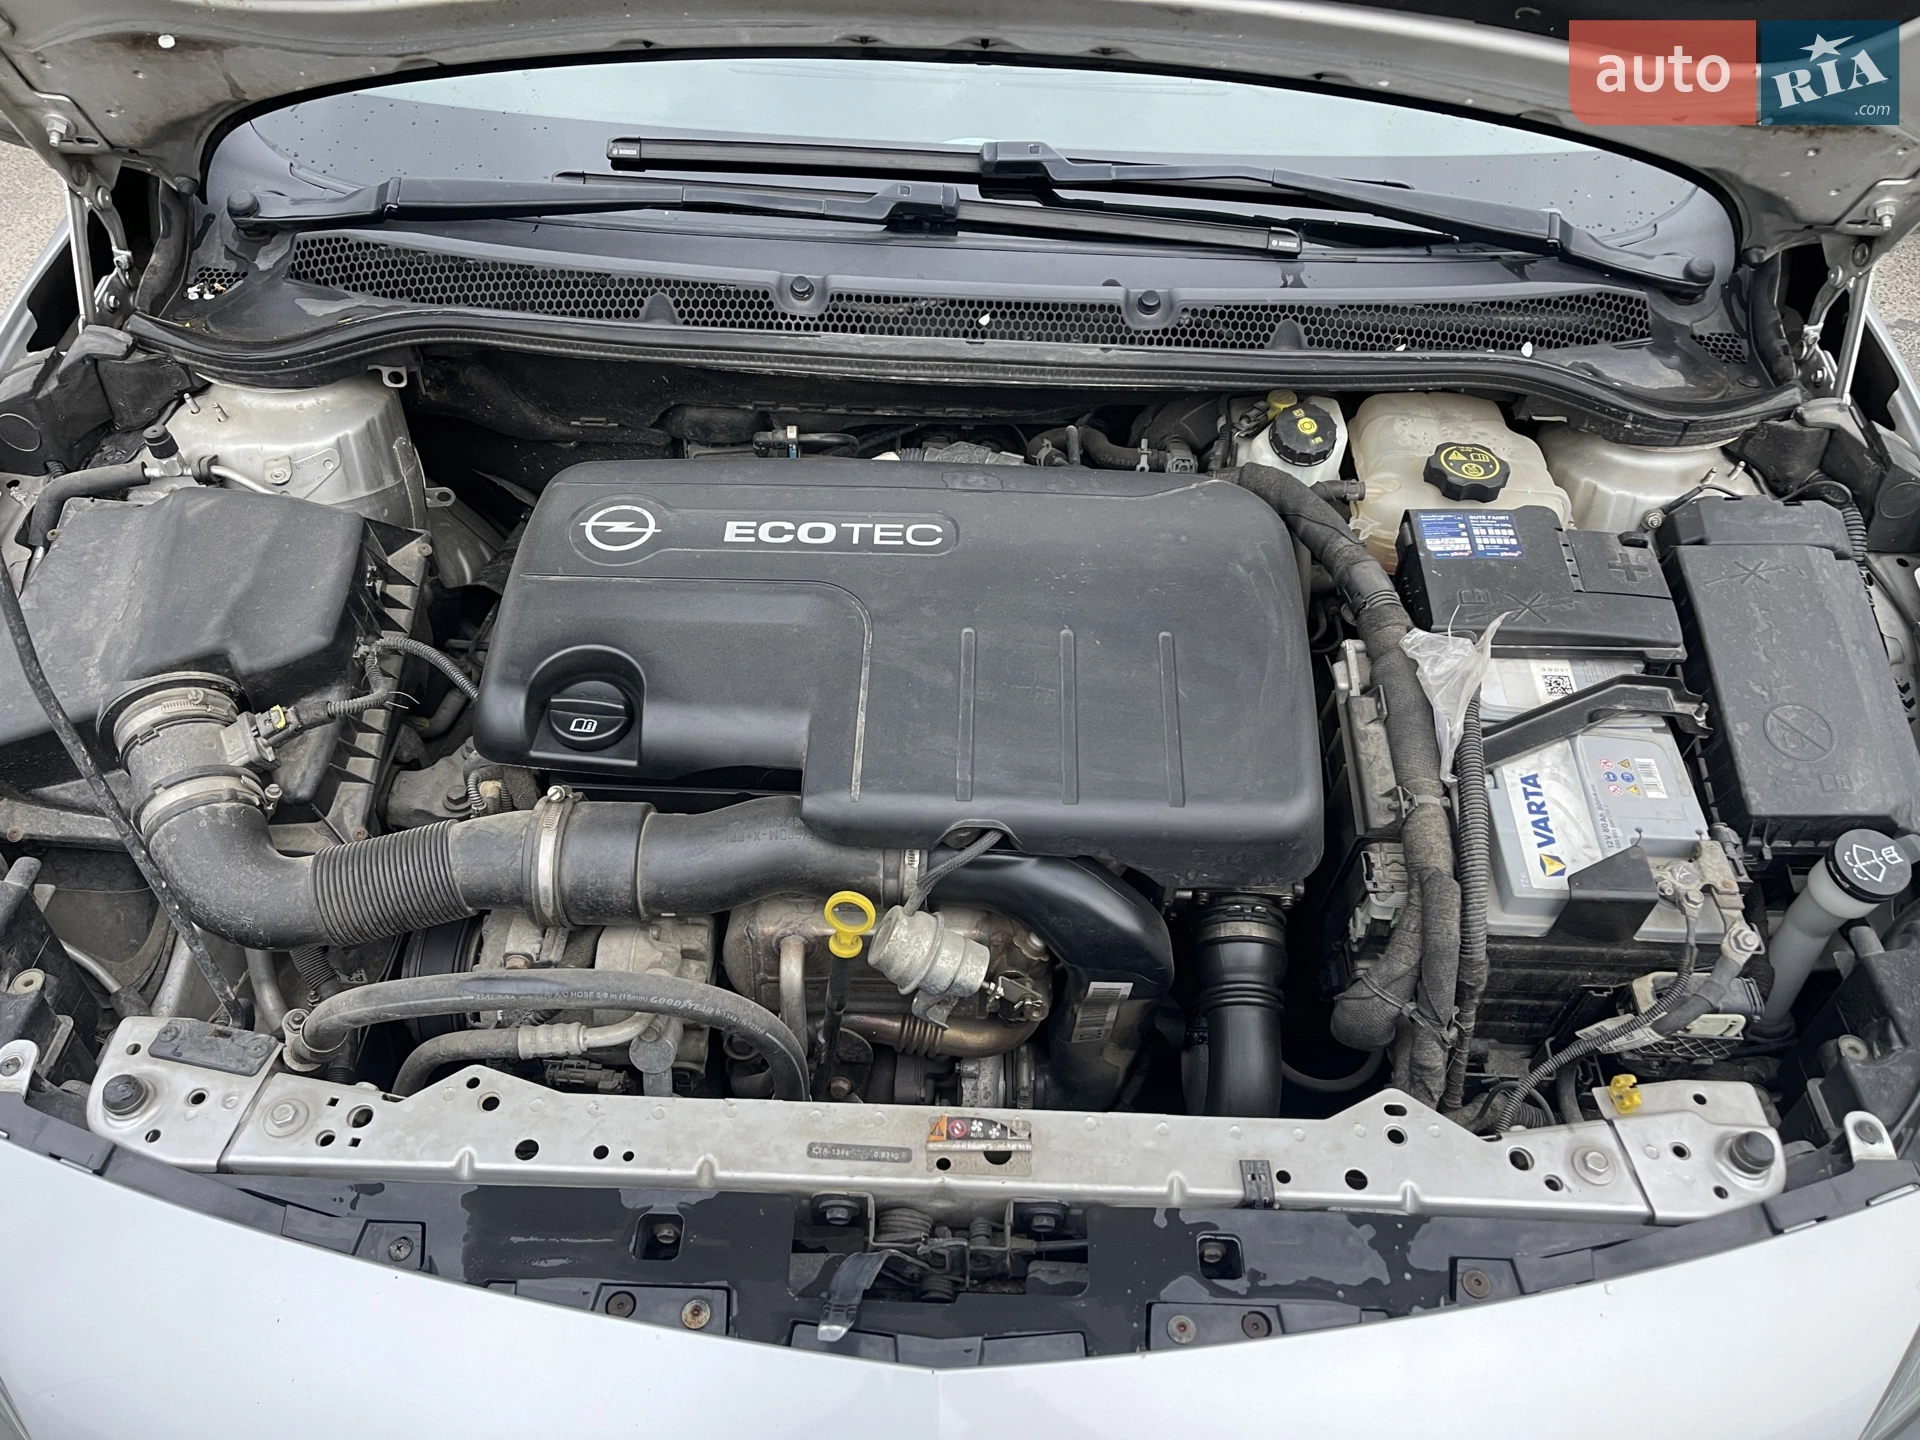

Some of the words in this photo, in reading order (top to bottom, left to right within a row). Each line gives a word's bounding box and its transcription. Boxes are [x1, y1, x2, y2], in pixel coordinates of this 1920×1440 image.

[723, 520, 943, 547] ECOTEC
[1520, 773, 1556, 849] VARTA
[619, 993, 648, 1003] (16mm)
[649, 996, 714, 1015] GOODYEAR
